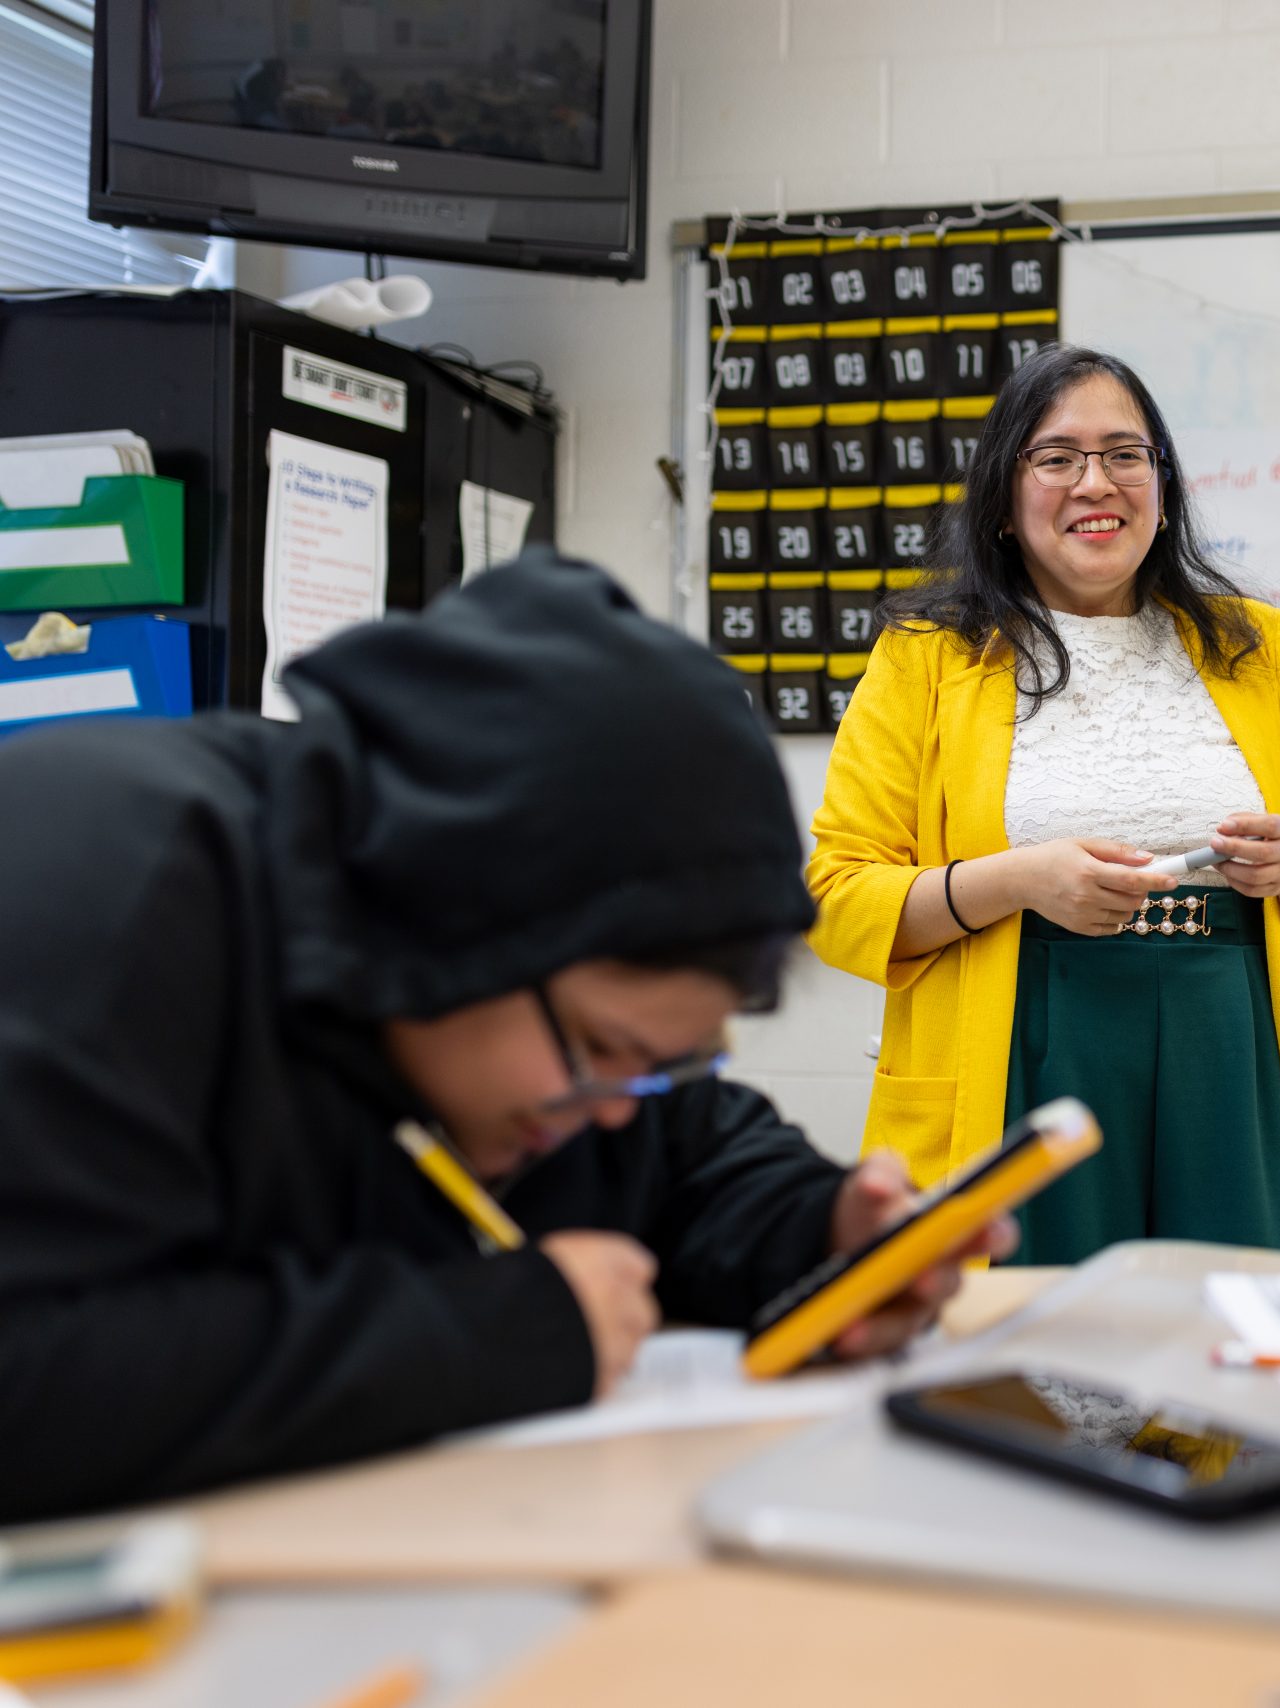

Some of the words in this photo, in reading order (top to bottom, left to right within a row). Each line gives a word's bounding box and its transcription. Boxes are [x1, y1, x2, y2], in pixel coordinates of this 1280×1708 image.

[721, 276, 753, 310] 01
[782, 271, 814, 306] 02
[831, 269, 866, 304] 03
[895, 265, 927, 300] 04
[952, 262, 985, 297] 05
[1011, 259, 1043, 294] 06
[723, 357, 755, 390] 07
[776, 353, 812, 389] 08
[890, 347, 925, 382] 10
[957, 343, 983, 379] 11
[719, 437, 752, 471] 13
[778, 441, 810, 475] 14
[833, 439, 865, 473] 15
[893, 435, 925, 469] 16
[719, 526, 752, 560] 19
[778, 526, 811, 559] 20
[834, 525, 866, 558] 21
[893, 524, 926, 557] 22
[722, 606, 755, 639] 25
[780, 606, 814, 639] 26
[840, 608, 871, 641] 27
[777, 687, 810, 720] 32
[828, 690, 854, 721] 3
